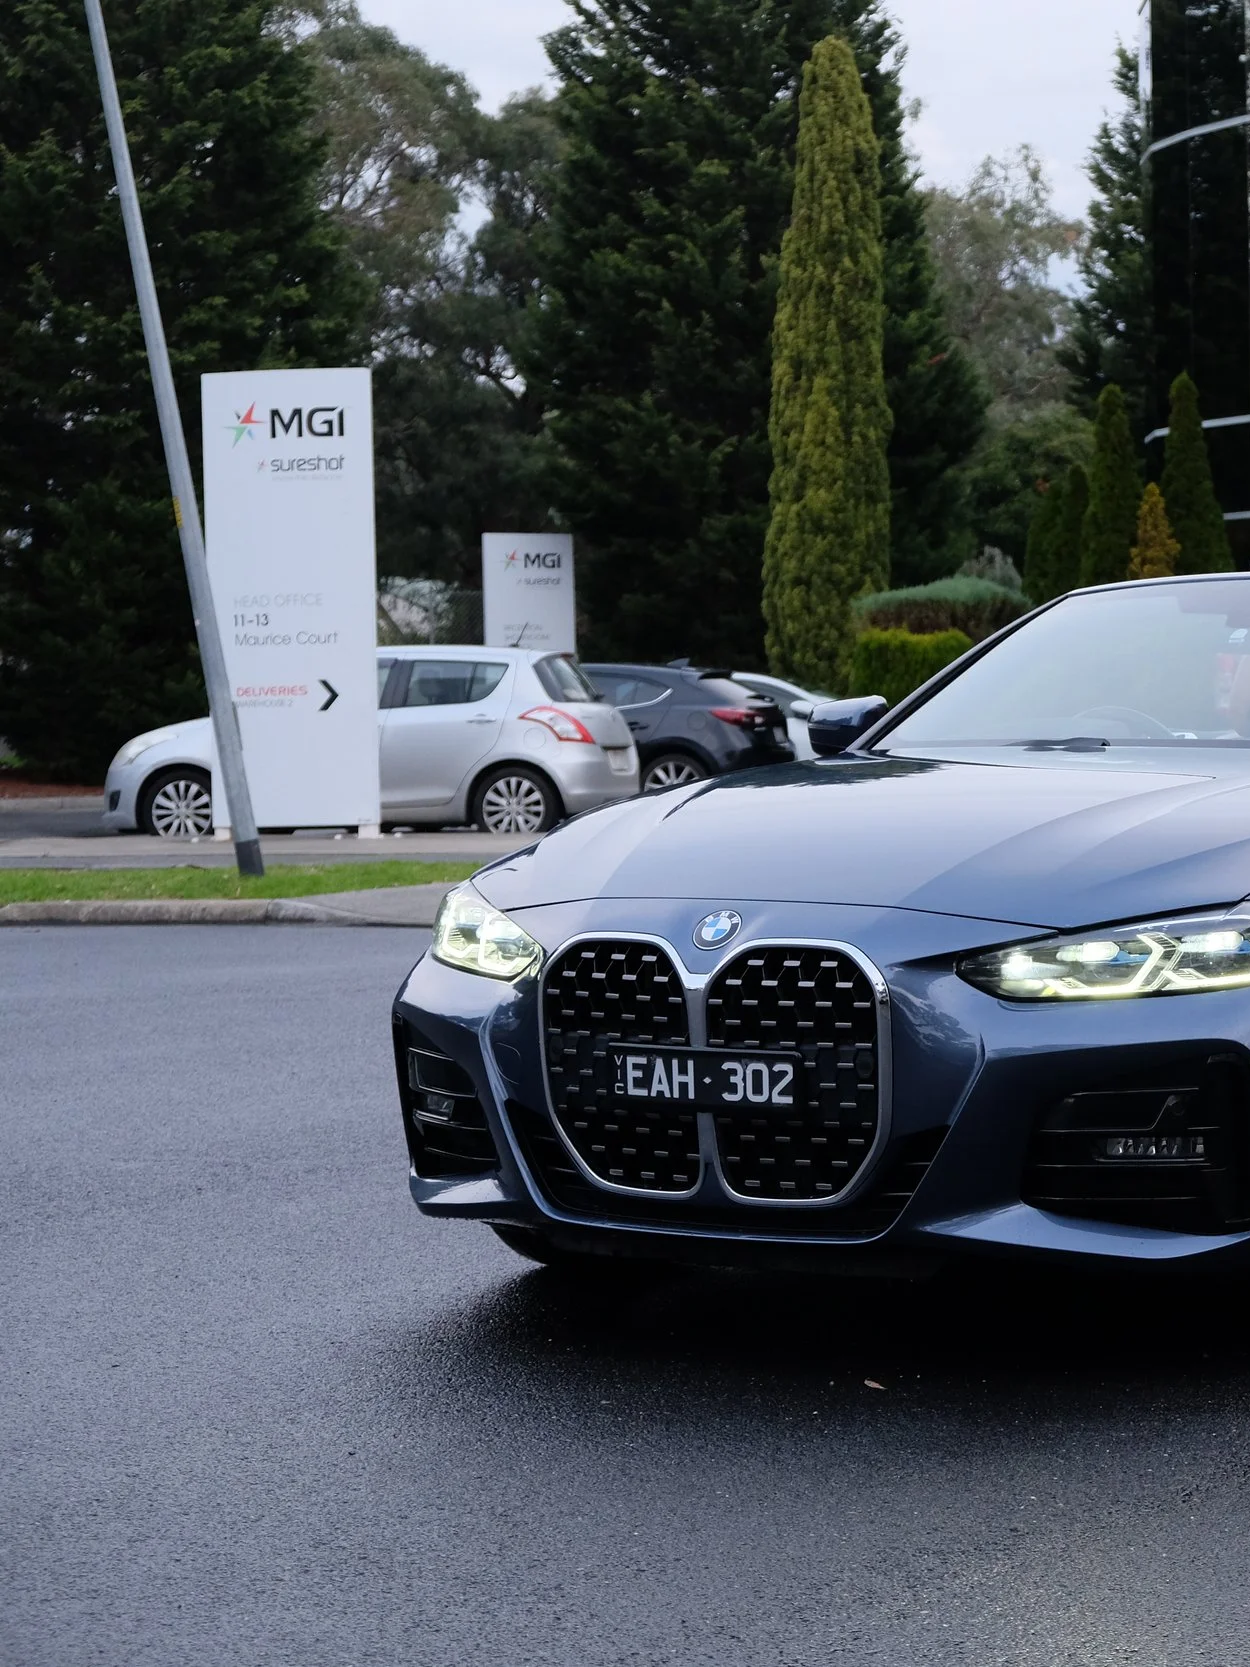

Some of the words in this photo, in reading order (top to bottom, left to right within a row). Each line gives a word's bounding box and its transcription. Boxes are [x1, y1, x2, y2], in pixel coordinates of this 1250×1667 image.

[269, 406, 345, 439] MGI
[270, 453, 345, 473] sureshot
[523, 552, 561, 568] MGI
[524, 576, 561, 586] sureshot
[233, 594, 270, 608] HEAD
[273, 592, 323, 607] OFFICE
[233, 613, 269, 627] 11-13
[235, 633, 291, 646] Maurice
[295, 630, 339, 645] Court
[236, 685, 308, 697] DELIVERIES
[613, 1054, 625, 1095] VIC
[626, 1055, 695, 1100] EAH
[721, 1061, 794, 1105] 302
